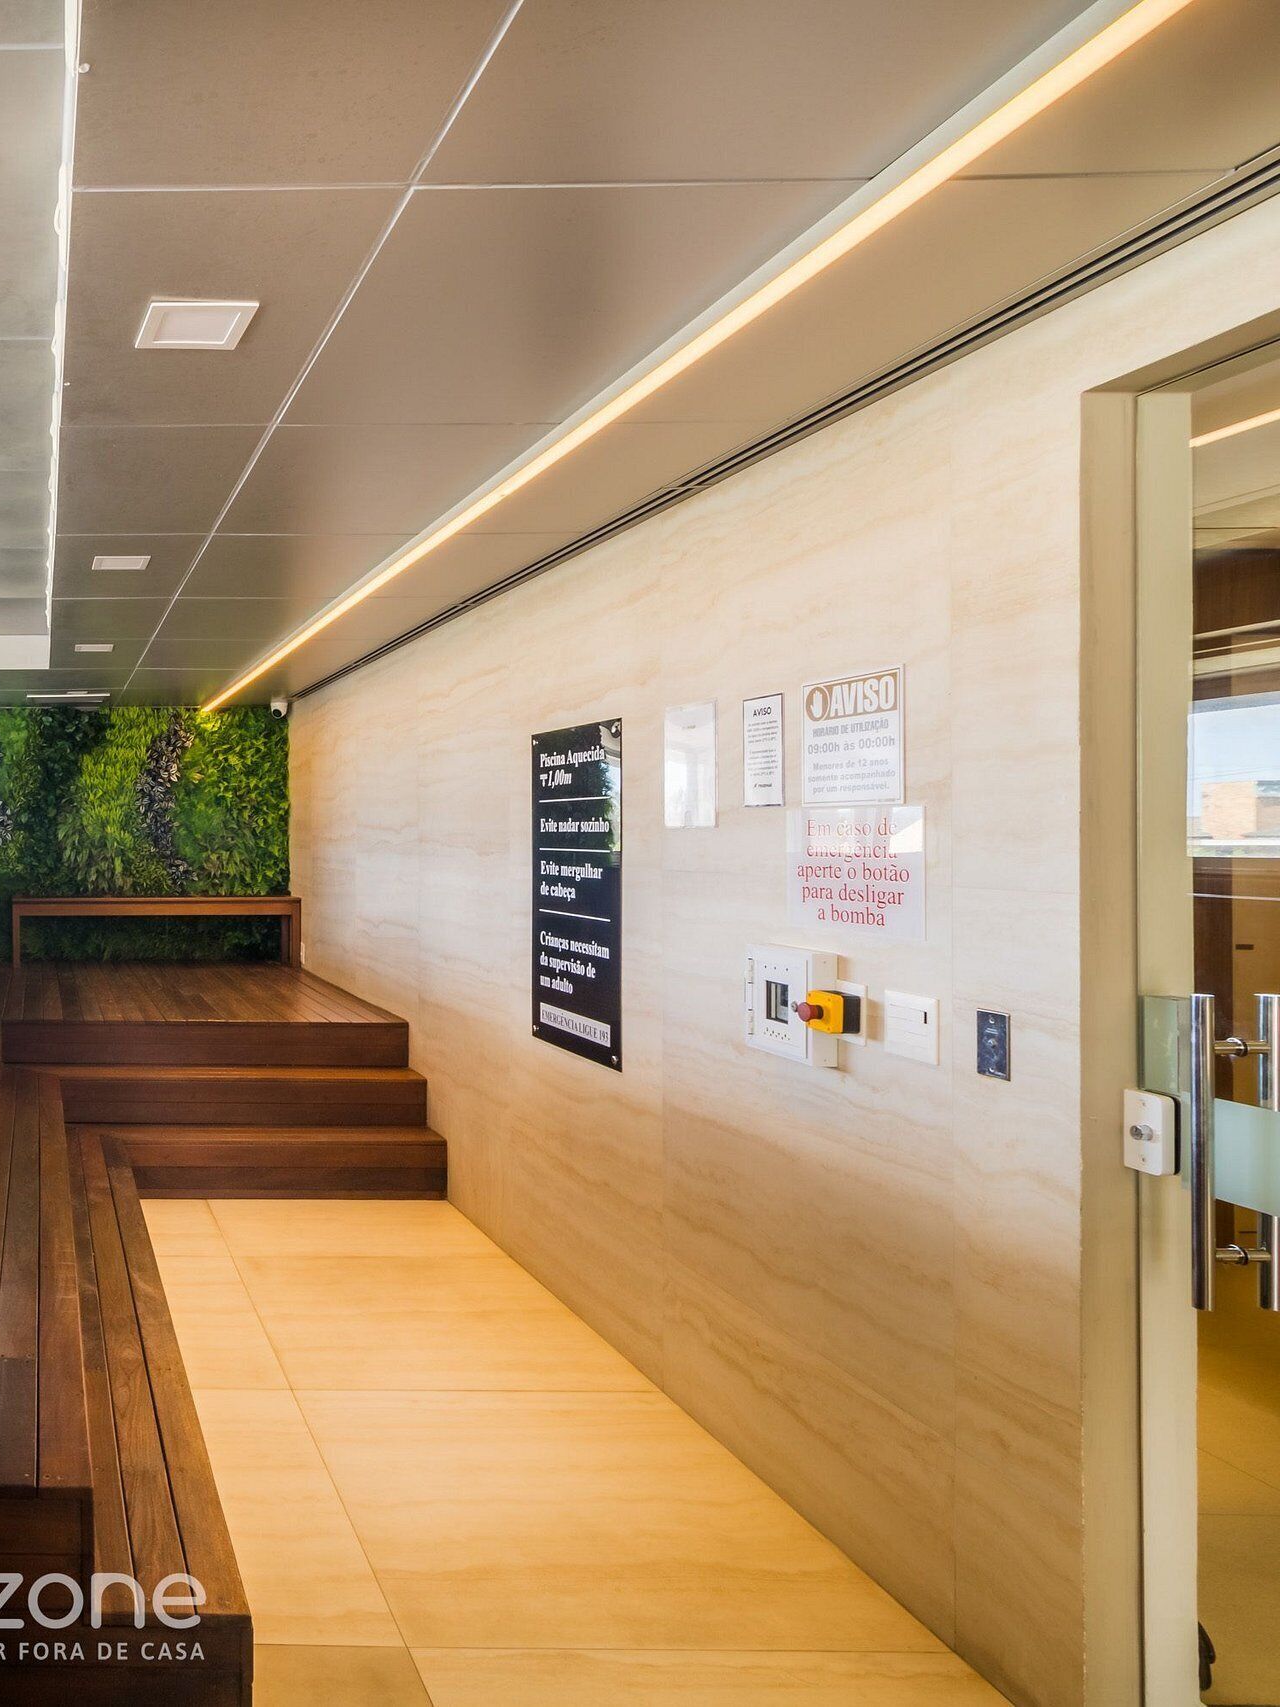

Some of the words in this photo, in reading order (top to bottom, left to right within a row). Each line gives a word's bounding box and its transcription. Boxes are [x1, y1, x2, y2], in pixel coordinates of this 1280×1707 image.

[829, 675, 895, 717] AVISO
[753, 706, 772, 717] AVISO
[840, 724, 849, 735] DE
[850, 717, 889, 733] UTILIZAÇÃO
[807, 741, 840, 755] 09:00h
[844, 740, 856, 751] às
[858, 735, 895, 750] 00:00h
[540, 751, 565, 768] Piscina
[566, 745, 605, 769] Aquecida
[813, 760, 844, 771] Menores
[845, 759, 856, 769] de
[869, 757, 889, 767] anos
[547, 769, 572, 789] 1,00m
[812, 784, 826, 796] por
[826, 784, 838, 793] um
[540, 817, 558, 833] Evite
[558, 818, 580, 833] nadar
[580, 816, 610, 833] sozinho
[807, 819, 831, 836] Em
[836, 821, 872, 837] caso
[877, 817, 897, 836] de
[540, 860, 559, 876] Evite
[560, 862, 603, 882] mergulhar
[797, 863, 842, 882] aperte
[847, 866, 857, 879] o
[862, 862, 910, 882] botão
[540, 880, 550, 895] de
[550, 882, 576, 901] cabeça
[802, 885, 833, 903] para
[838, 883, 904, 909] desligar
[818, 907, 826, 920] a
[831, 903, 885, 927] bomba
[540, 930, 569, 952] Crianças
[569, 940, 610, 960] necessitam
[540, 951, 548, 966] da
[549, 957, 585, 977] supervisão
[586, 962, 596, 979] de
[540, 975, 551, 988] um
[551, 976, 574, 995] adulto
[541, 1009, 579, 1033] EMERGÊNCIA
[578, 1021, 598, 1039] LIGUE
[599, 1029, 609, 1043] 193
